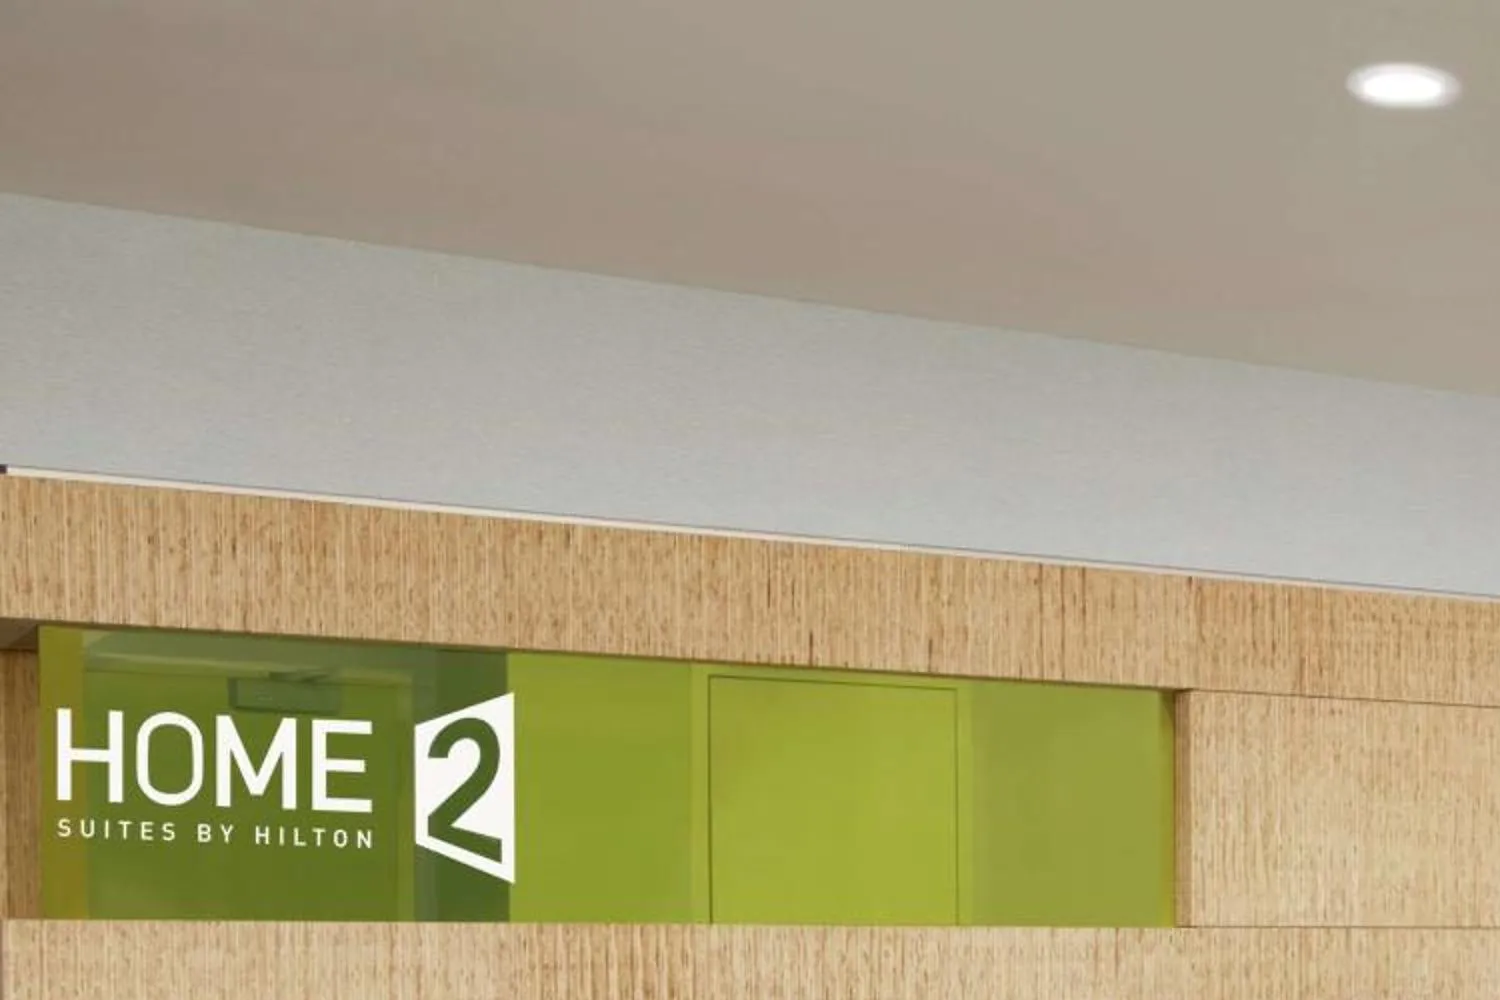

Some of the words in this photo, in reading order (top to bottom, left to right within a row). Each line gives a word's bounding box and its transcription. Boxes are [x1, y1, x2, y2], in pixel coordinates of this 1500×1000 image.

[56, 708, 373, 813] HOME
[426, 715, 504, 864] 2
[57, 818, 176, 841] SUITES
[197, 823, 234, 843] BY
[255, 826, 373, 849] HILTON
